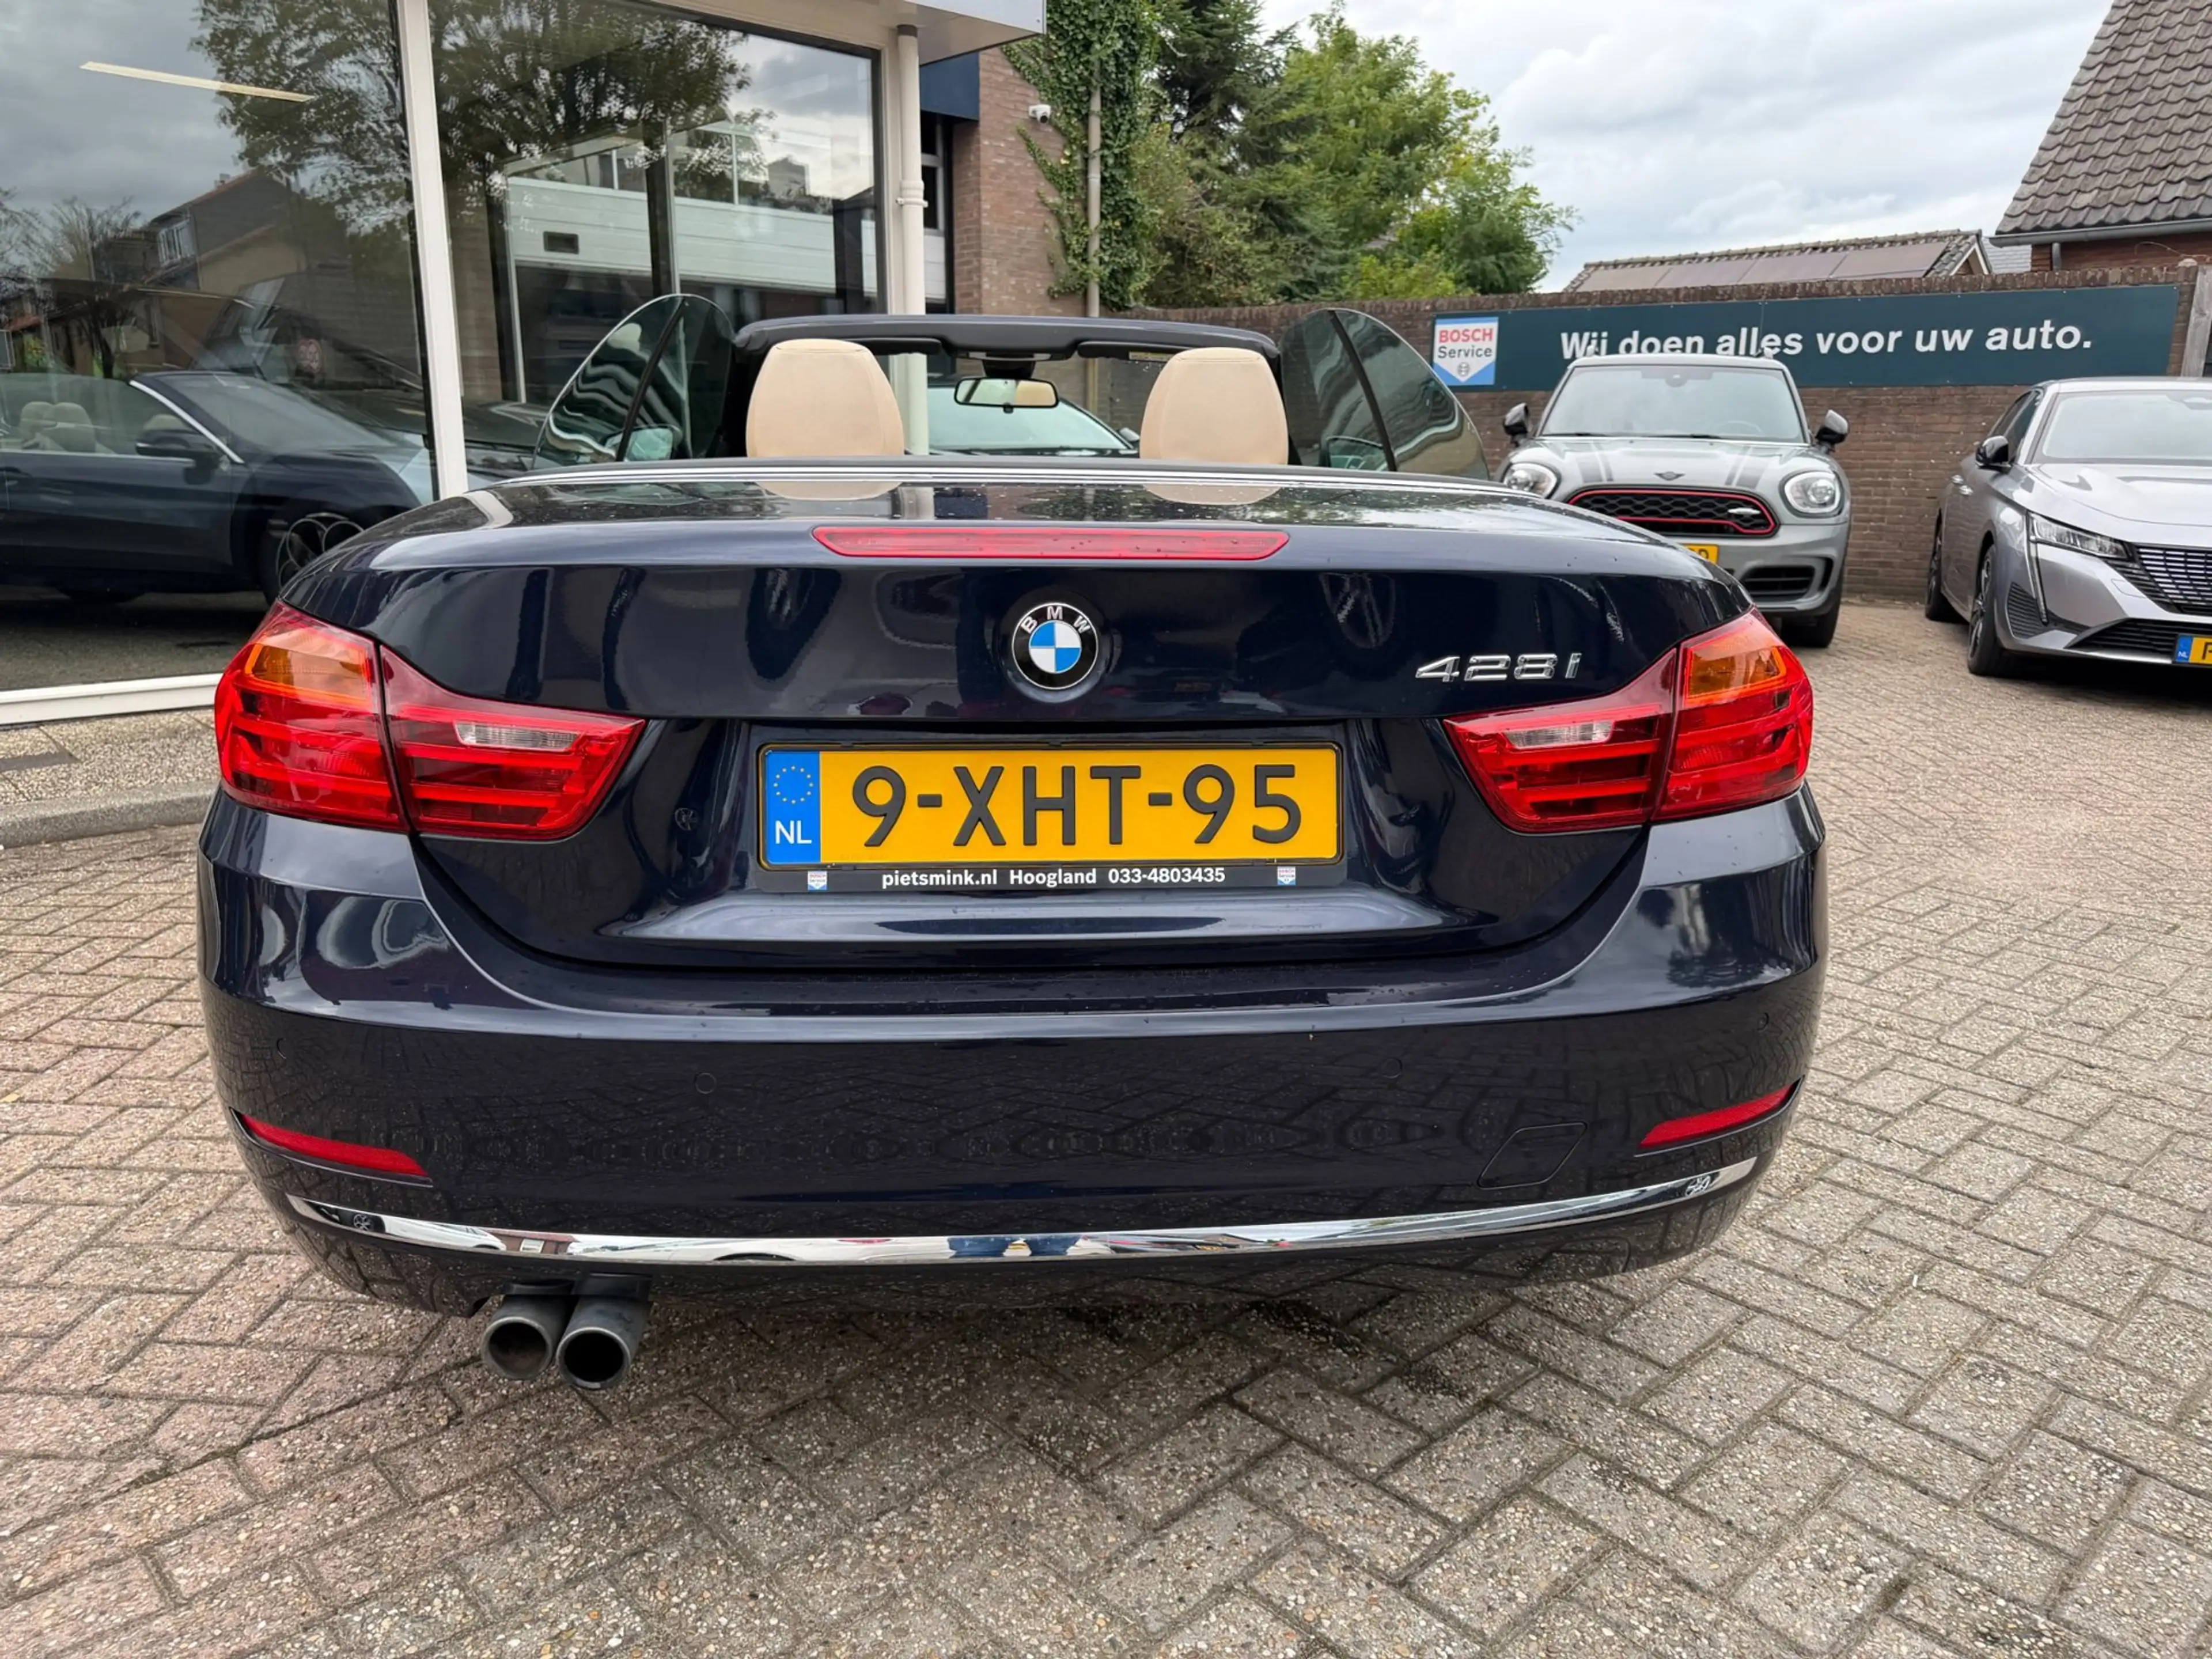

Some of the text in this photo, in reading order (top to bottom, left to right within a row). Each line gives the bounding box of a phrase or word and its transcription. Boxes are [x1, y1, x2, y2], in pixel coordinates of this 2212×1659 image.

[1439, 328, 1493, 343] BOSCH
[1560, 319, 2092, 359] Wij doen alles voor uw auto.
[1438, 344, 1493, 359] Service
[1021, 605, 1090, 635] BMW
[2177, 650, 2188, 658] NL
[1415, 653, 1583, 683] 428i
[775, 763, 1302, 848] NL 9-XHT-95
[881, 866, 1226, 889] pietsmink.nl Hoogland 033-4803435
